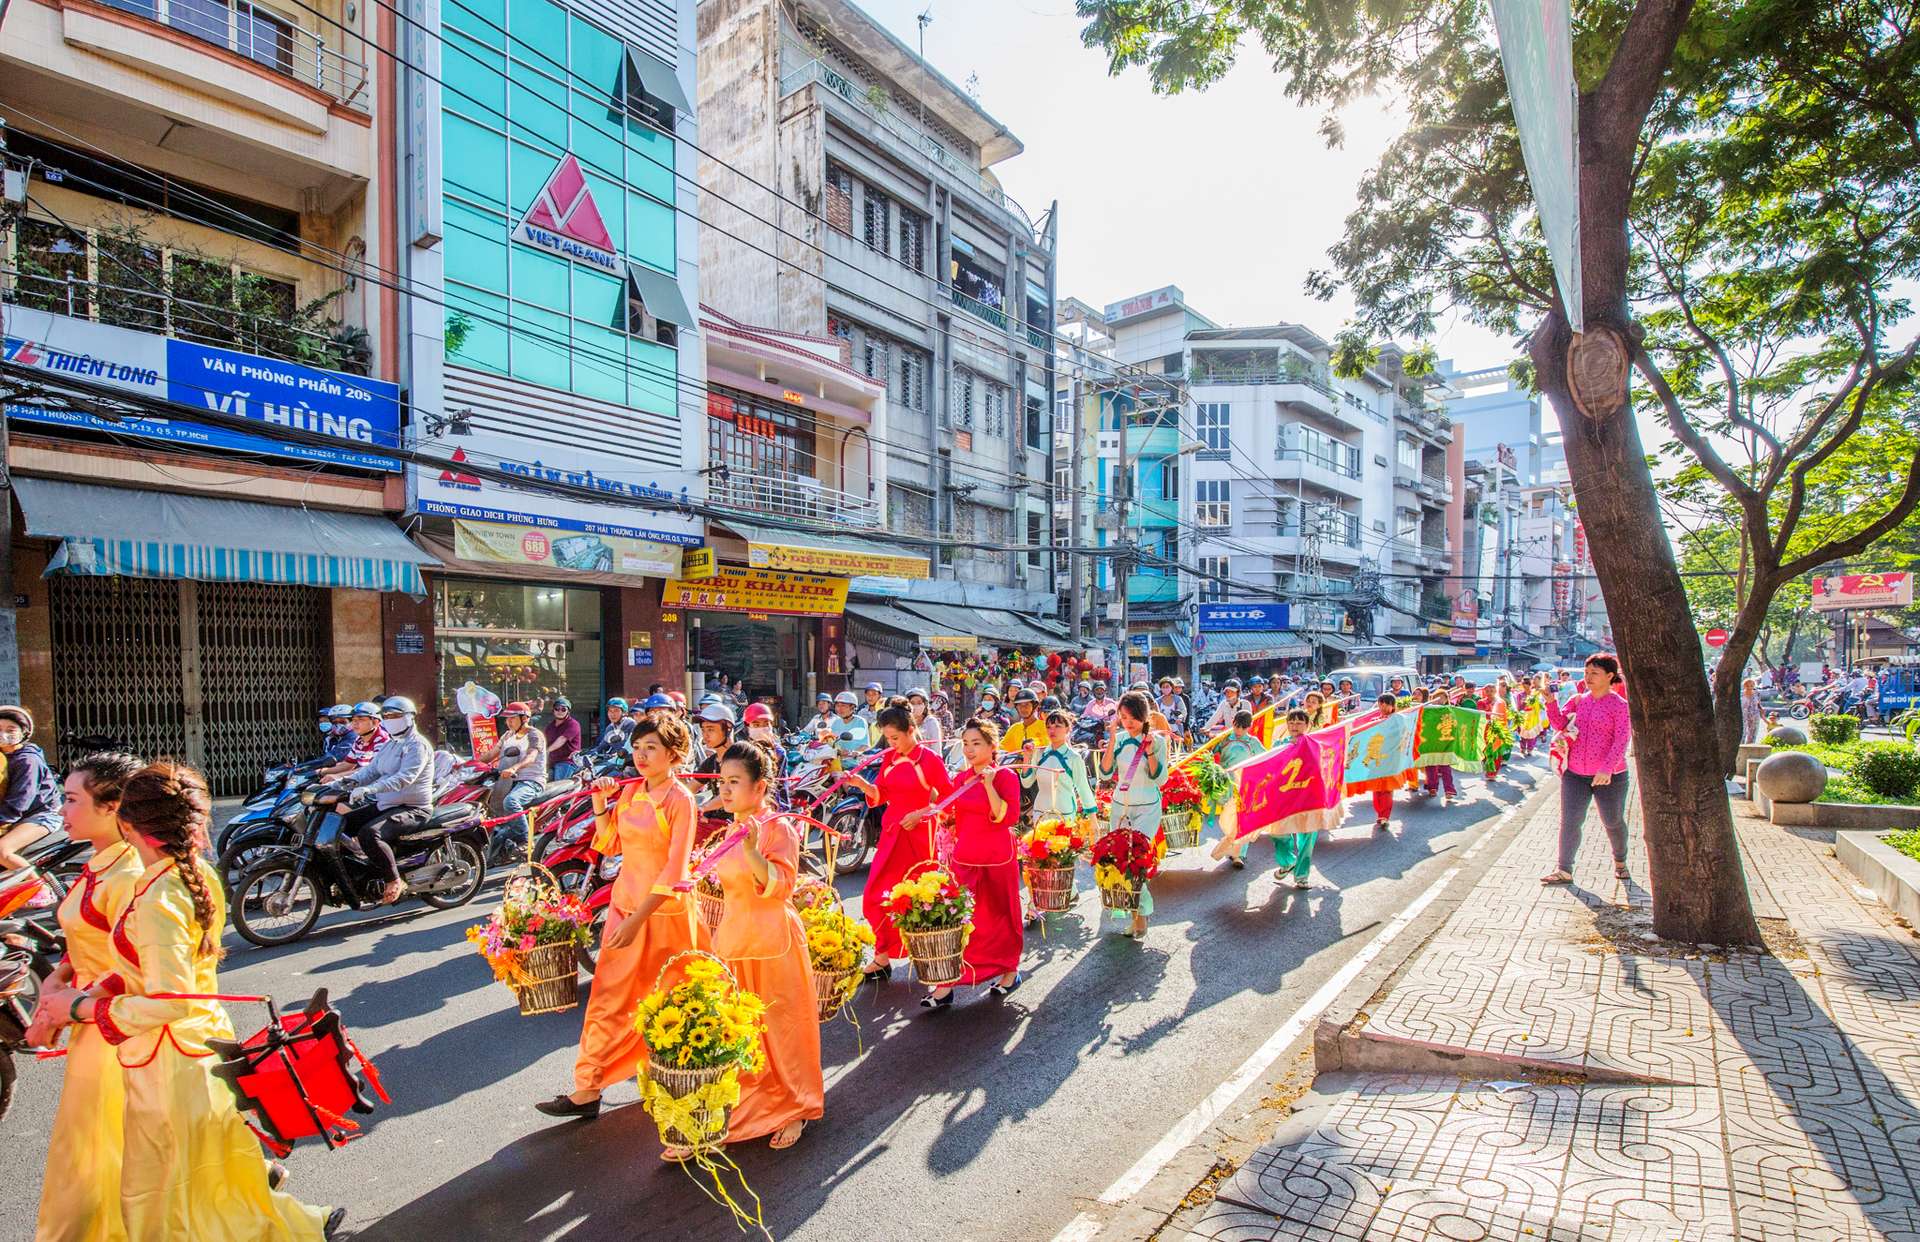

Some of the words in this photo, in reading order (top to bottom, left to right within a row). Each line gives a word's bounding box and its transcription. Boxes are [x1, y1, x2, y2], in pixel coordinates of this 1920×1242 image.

[46, 350, 105, 377] THIÊN
[108, 362, 157, 386] LONG
[202, 357, 237, 375] VĂN
[241, 364, 295, 387] PHÒNG
[299, 377, 341, 396] PHẨM
[345, 387, 372, 402] 205
[263, 401, 373, 444] HÙNG
[460, 507, 482, 517] GIAO
[585, 524, 596, 532] 207
